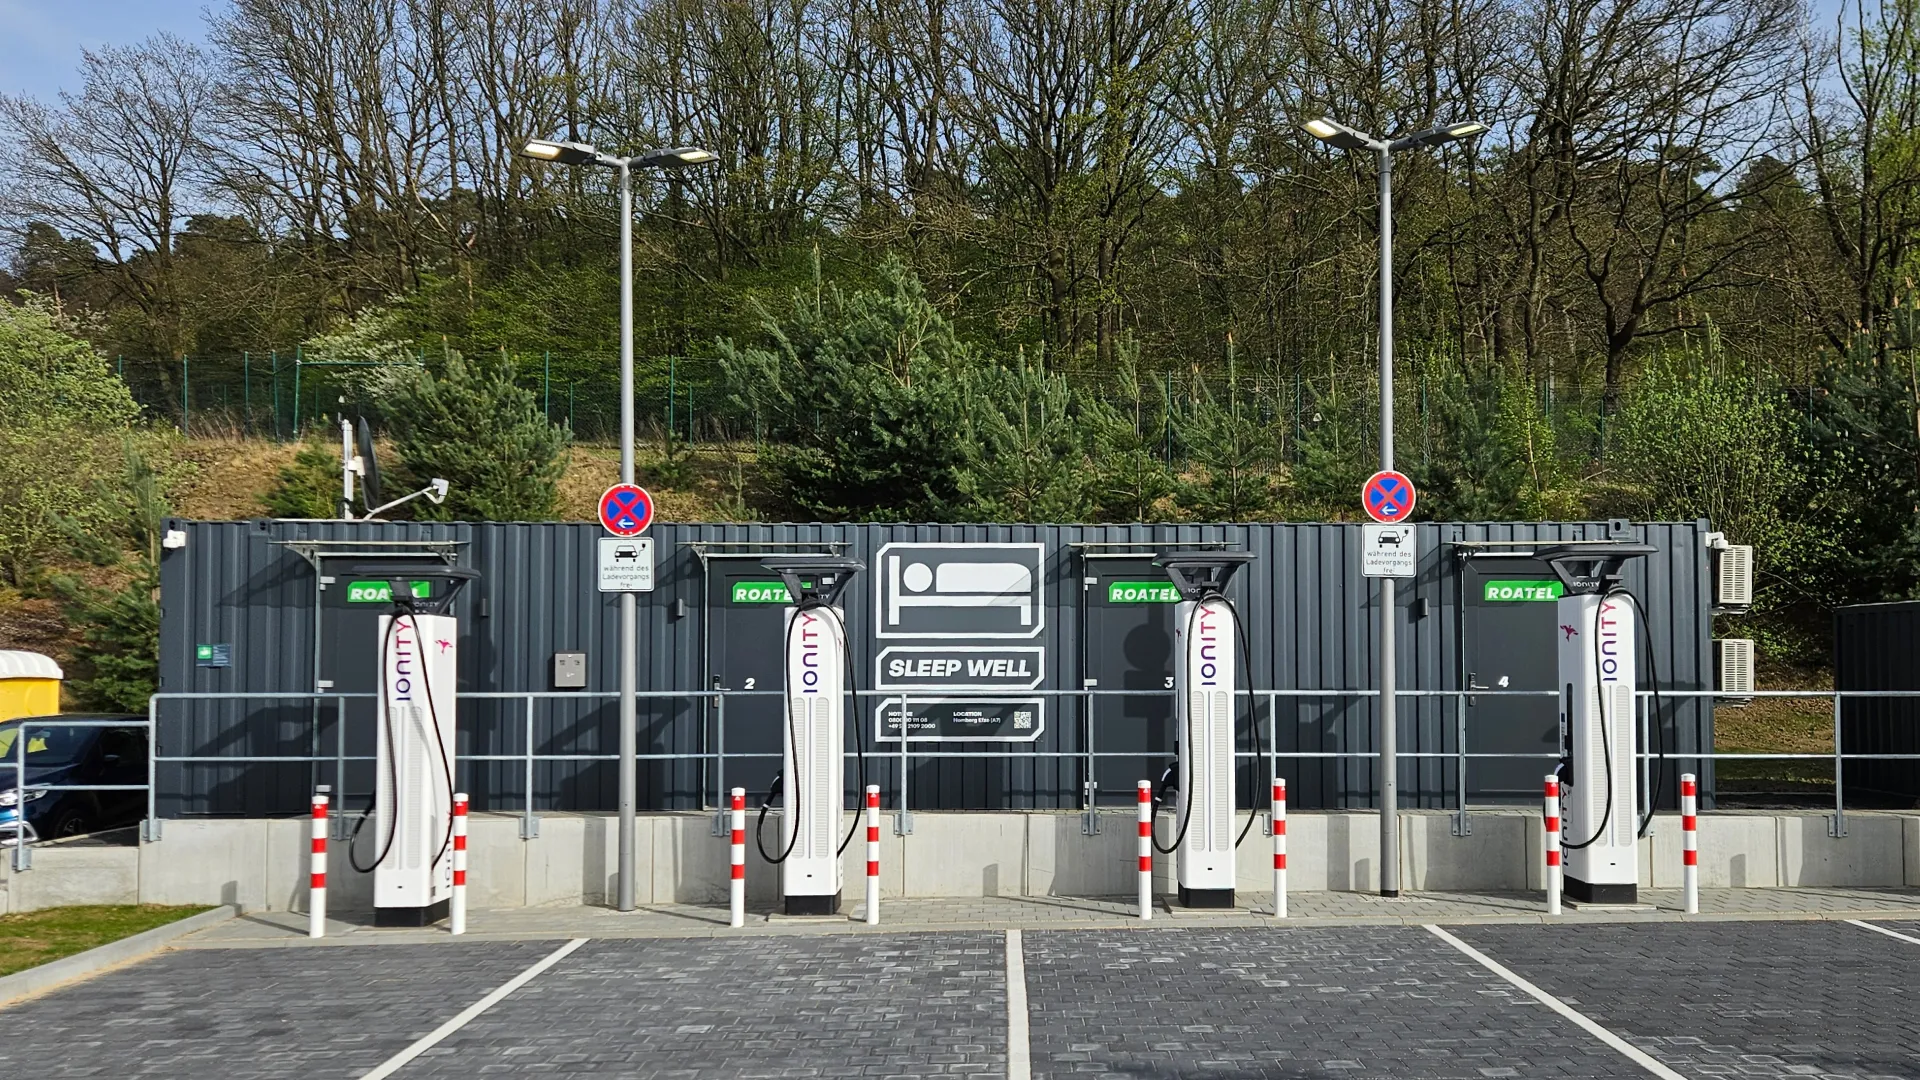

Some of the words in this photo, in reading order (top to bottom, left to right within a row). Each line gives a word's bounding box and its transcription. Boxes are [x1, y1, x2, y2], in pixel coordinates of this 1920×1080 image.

[1366, 559, 1412, 567] Ladevorgangs
[350, 588, 421, 600] ROAL
[735, 588, 795, 601] ROATE
[1112, 588, 1179, 600] ROATEL
[1488, 587, 1555, 599] ROATEL
[1200, 604, 1217, 686] IONITY
[1600, 601, 1617, 681] IONITY
[802, 611, 818, 693] IONITY
[395, 618, 412, 702] IONITY
[888, 659, 963, 677] SLEEP
[967, 659, 1031, 677] WELL
[744, 678, 755, 690] 2
[1164, 676, 1174, 688] 3
[1498, 675, 1509, 687] 4
